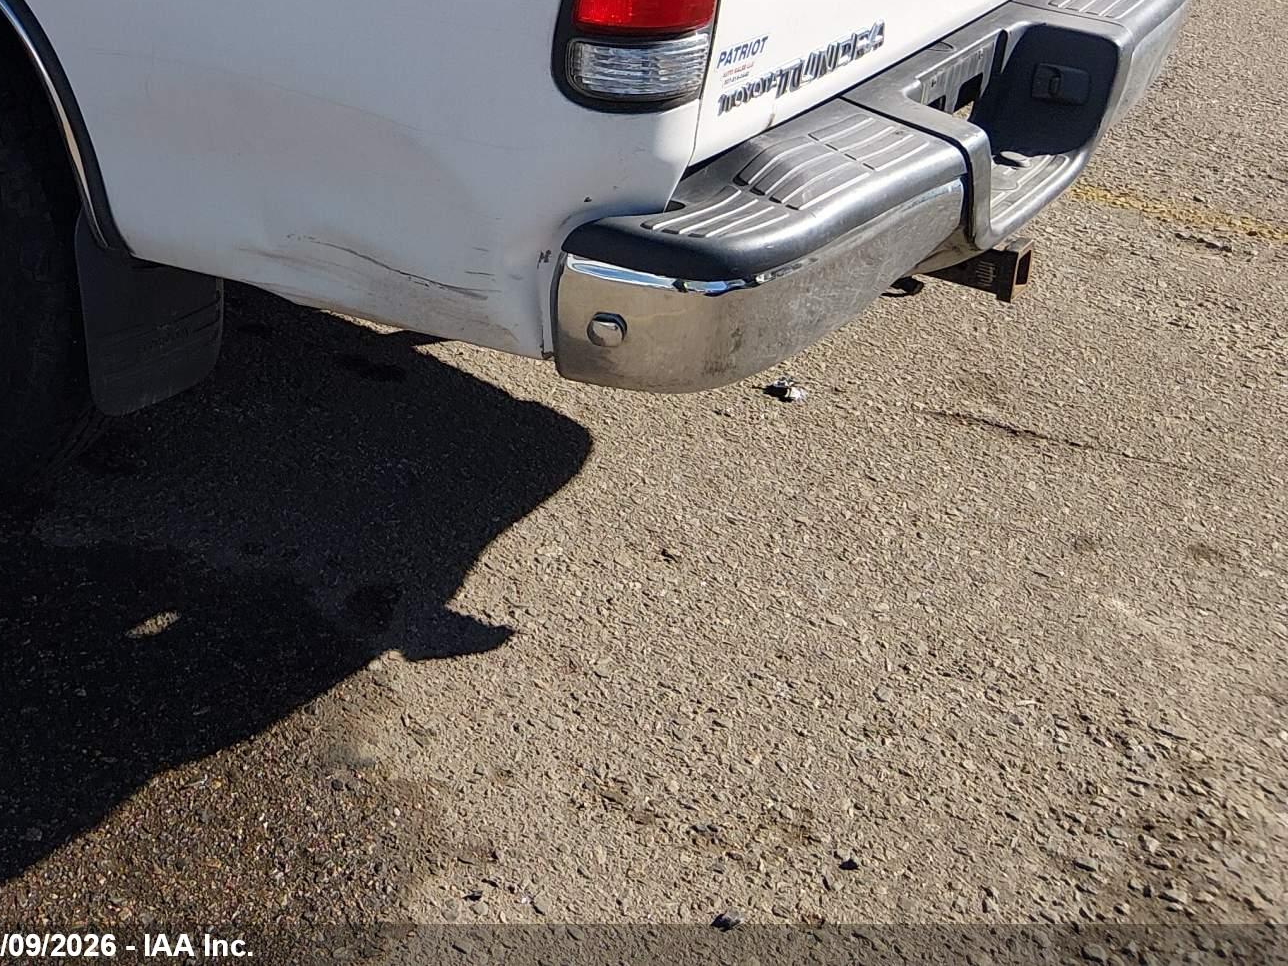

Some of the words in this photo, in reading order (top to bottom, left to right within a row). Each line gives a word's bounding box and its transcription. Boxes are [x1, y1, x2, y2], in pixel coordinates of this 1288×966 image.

[716, 35, 769, 69] PATRIOT
[718, 72, 776, 116] TOYOTA
[775, 19, 885, 98] TUNDRA
